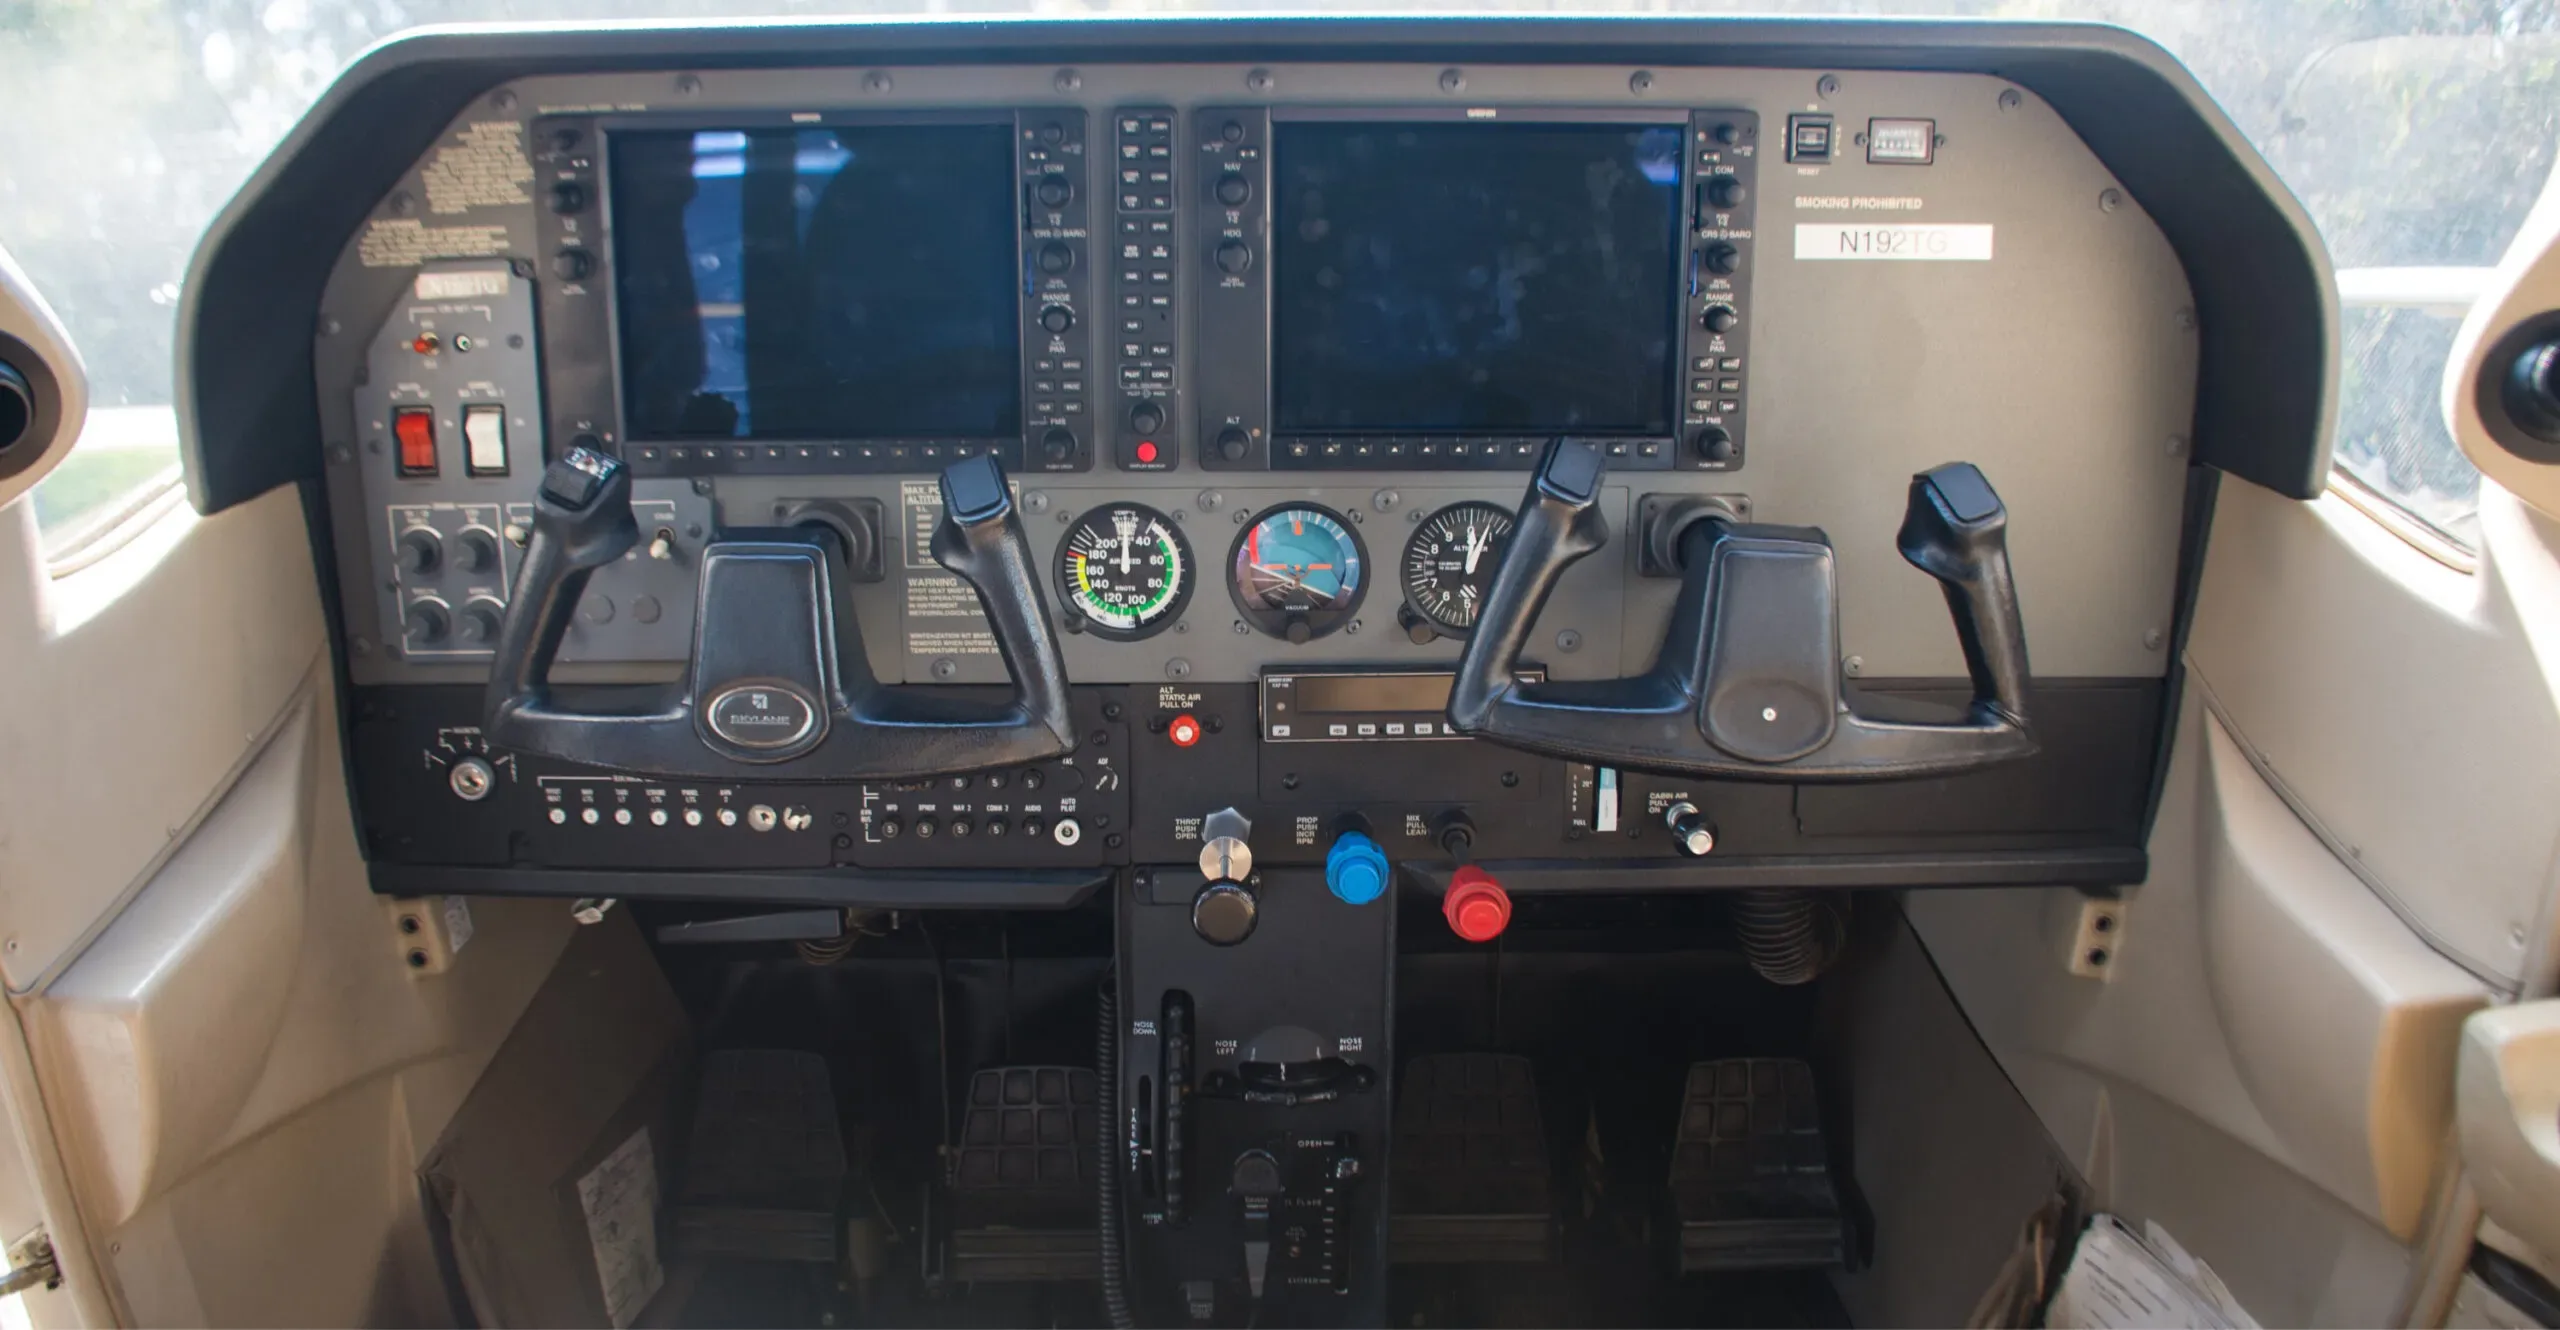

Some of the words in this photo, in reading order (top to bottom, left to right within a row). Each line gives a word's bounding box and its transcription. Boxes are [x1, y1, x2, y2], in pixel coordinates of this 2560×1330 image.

[1224, 161, 1241, 171] NAV
[1714, 166, 1735, 175] COM
[1795, 196, 1849, 209] SMOKING
[1852, 197, 1923, 210] PROHIBITED
[1701, 229, 1718, 239] CRS
[1729, 229, 1752, 239] BARO
[1840, 230, 1948, 254] N192TG
[1042, 292, 1071, 302] RANGE
[1705, 292, 1734, 302] RANGE
[1225, 415, 1240, 424] ALT
[1135, 536, 1151, 546] 40
[1445, 531, 1453, 543] 9
[1096, 539, 1117, 548] 200
[1431, 543, 1439, 554] 8
[1088, 550, 1107, 560] 180
[1149, 555, 1164, 565] 60
[1086, 565, 1104, 576] 160
[908, 577, 958, 587] WARNING
[1091, 579, 1109, 589] 140
[1148, 578, 1163, 588] 80
[1430, 578, 1438, 588] 7
[1104, 592, 1122, 603] 120
[1128, 595, 1147, 605] 100
[1443, 591, 1450, 601] 6
[1464, 599, 1471, 609] 5
[1160, 686, 1174, 694] ALT
[1160, 693, 1186, 701] STATIC
[1187, 693, 1201, 701] AIR
[991, 778, 998, 787] 5
[1028, 780, 1034, 788] 5
[1024, 804, 1042, 812] AUDIO
[957, 825, 964, 833] 5
[993, 826, 1000, 834] 5
[1029, 827, 1035, 835] 5
[1175, 832, 1197, 840] OPEN
[1133, 1028, 1156, 1036] DOWN
[1339, 1037, 1362, 1045] NOSE
[1339, 1044, 1362, 1052] RIGHT
